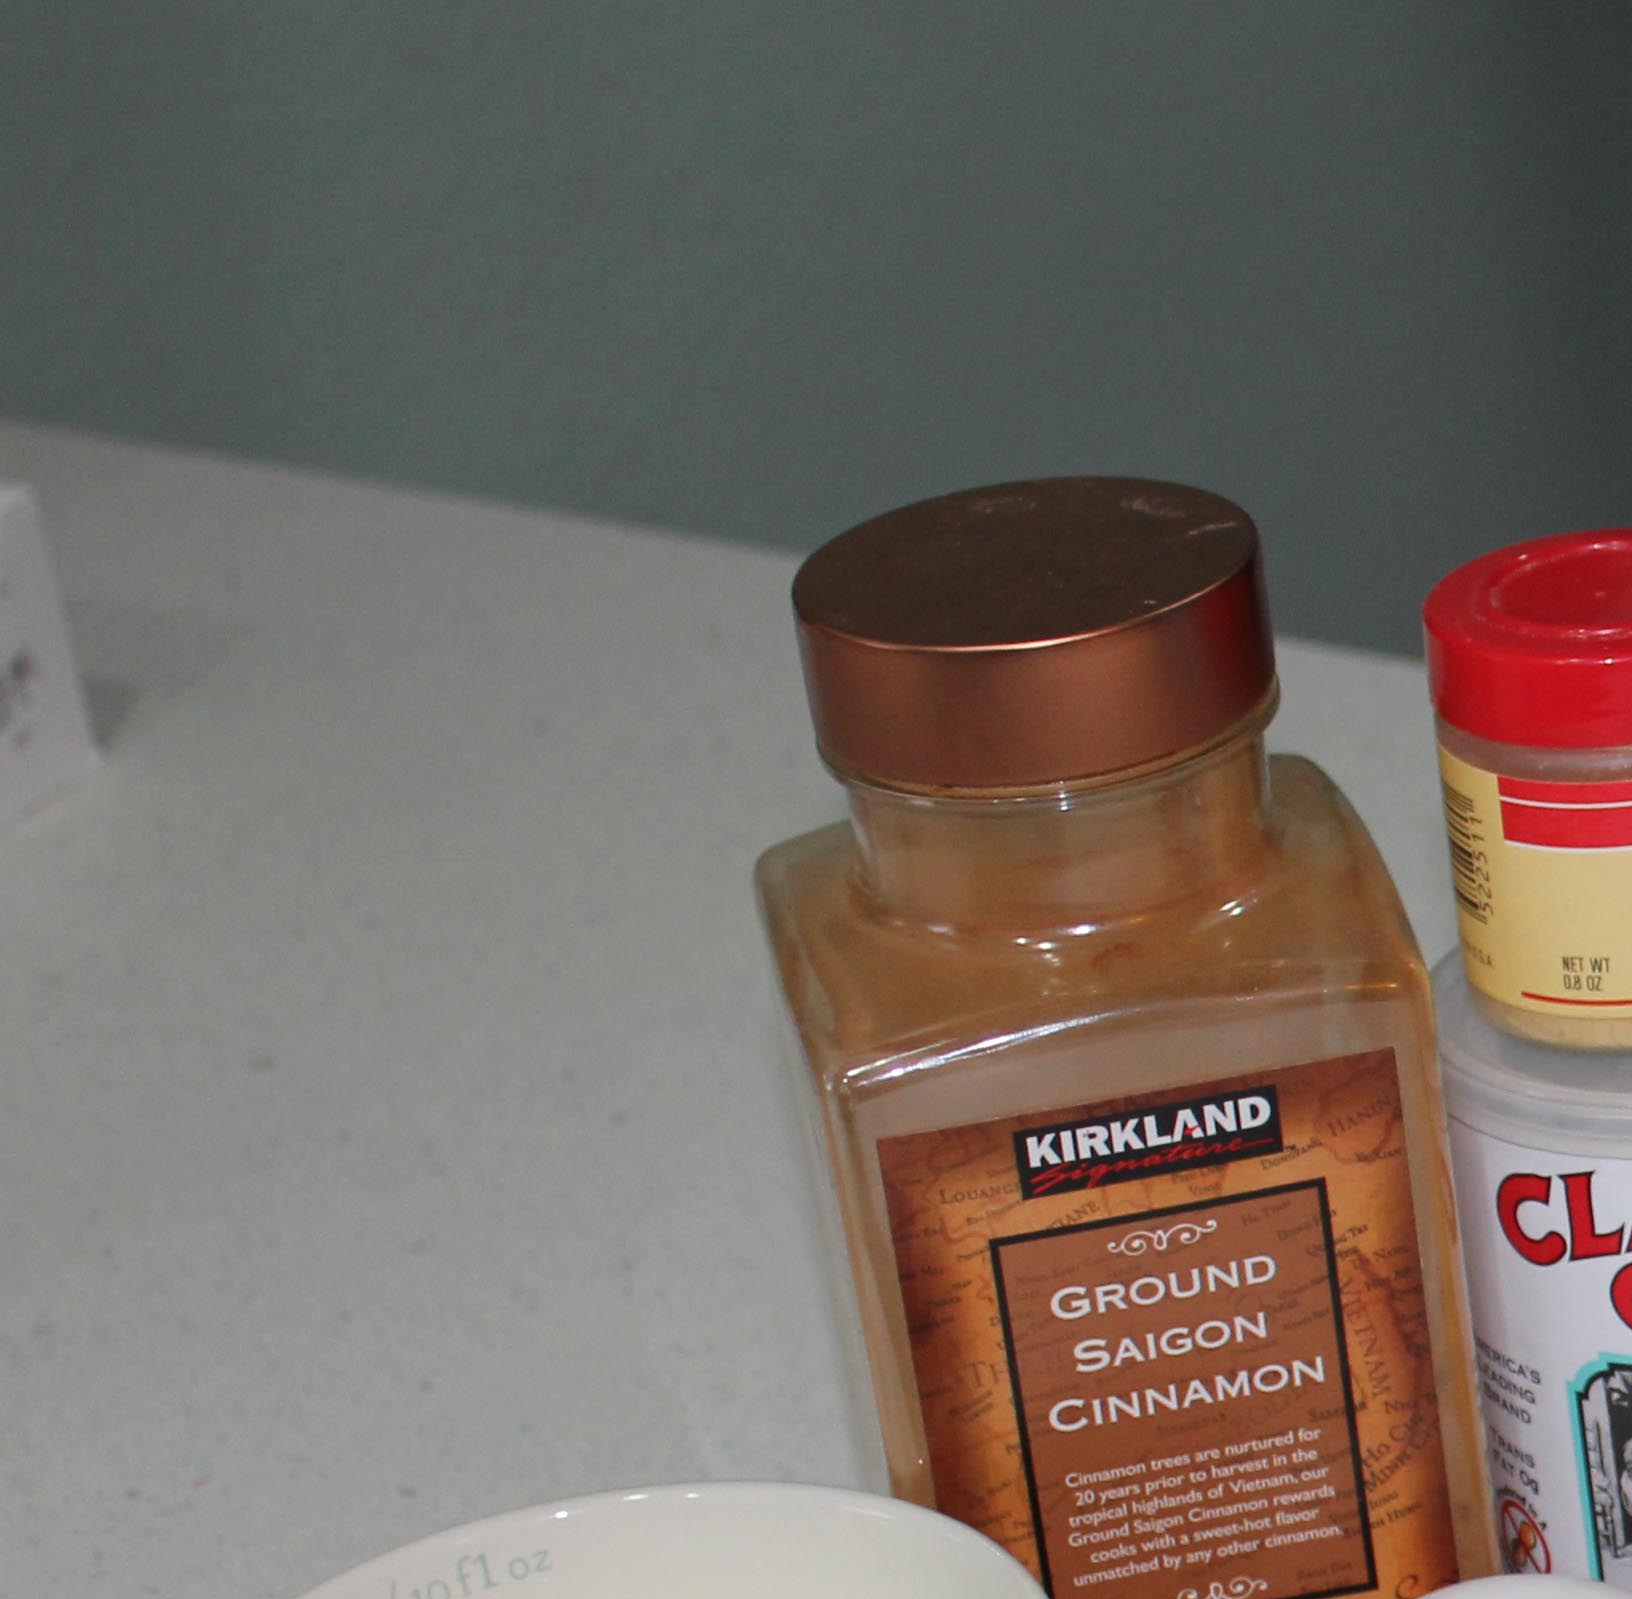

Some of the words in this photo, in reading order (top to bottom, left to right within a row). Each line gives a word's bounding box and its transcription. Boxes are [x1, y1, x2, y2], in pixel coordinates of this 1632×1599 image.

[1562, 956, 1585, 972] NET
[1589, 957, 1611, 974] WT
[1562, 974, 1582, 991] 0.8
[1586, 975, 1603, 992] OZ
[1026, 1096, 1272, 1168] KIRKLAND
[1029, 1137, 1275, 1195] Signature
[1049, 1254, 1277, 1320] GROUND
[1073, 1311, 1268, 1373] SAIGON
[1047, 1355, 1326, 1433] CINNAMON
[1065, 1463, 1147, 1488] Cinnamon
[1151, 1451, 1191, 1470] trees
[1195, 1448, 1220, 1461] are
[1224, 1430, 1294, 1455] nurtured
[1297, 1427, 1321, 1445] for
[1075, 1491, 1096, 1507] 20
[1099, 1481, 1141, 1505] years
[1145, 1473, 1185, 1496] prior
[1189, 1469, 1207, 1483] to
[1211, 1457, 1269, 1478] harvest
[1272, 1452, 1288, 1467] in
[1292, 1447, 1318, 1464] the
[1068, 1525, 1130, 1548] Ground
[1133, 1513, 1185, 1537] Saigon
[1188, 1496, 1269, 1523] Cinnamon
[1273, 1484, 1336, 1507] rewards
[1069, 1503, 1128, 1529] tropical
[1132, 1489, 1204, 1516] highlands
[1207, 1484, 1225, 1500] of
[1229, 1470, 1299, 1496] Vietnam,
[1301, 1465, 1329, 1482] our
[506, 1547, 554, 1582] oz
[1073, 1556, 1159, 1588] unmatched
[1163, 1552, 1182, 1570] by
[1186, 1548, 1212, 1568] any
[1216, 1537, 1260, 1558] other
[1264, 1523, 1344, 1549] cinnamon.
[1090, 1543, 1137, 1563] cooks
[1141, 1534, 1177, 1553] with
[1180, 1533, 1190, 1546] a
[1193, 1517, 1272, 1542] sweet-hot
[1276, 1507, 1320, 1527] flavor
